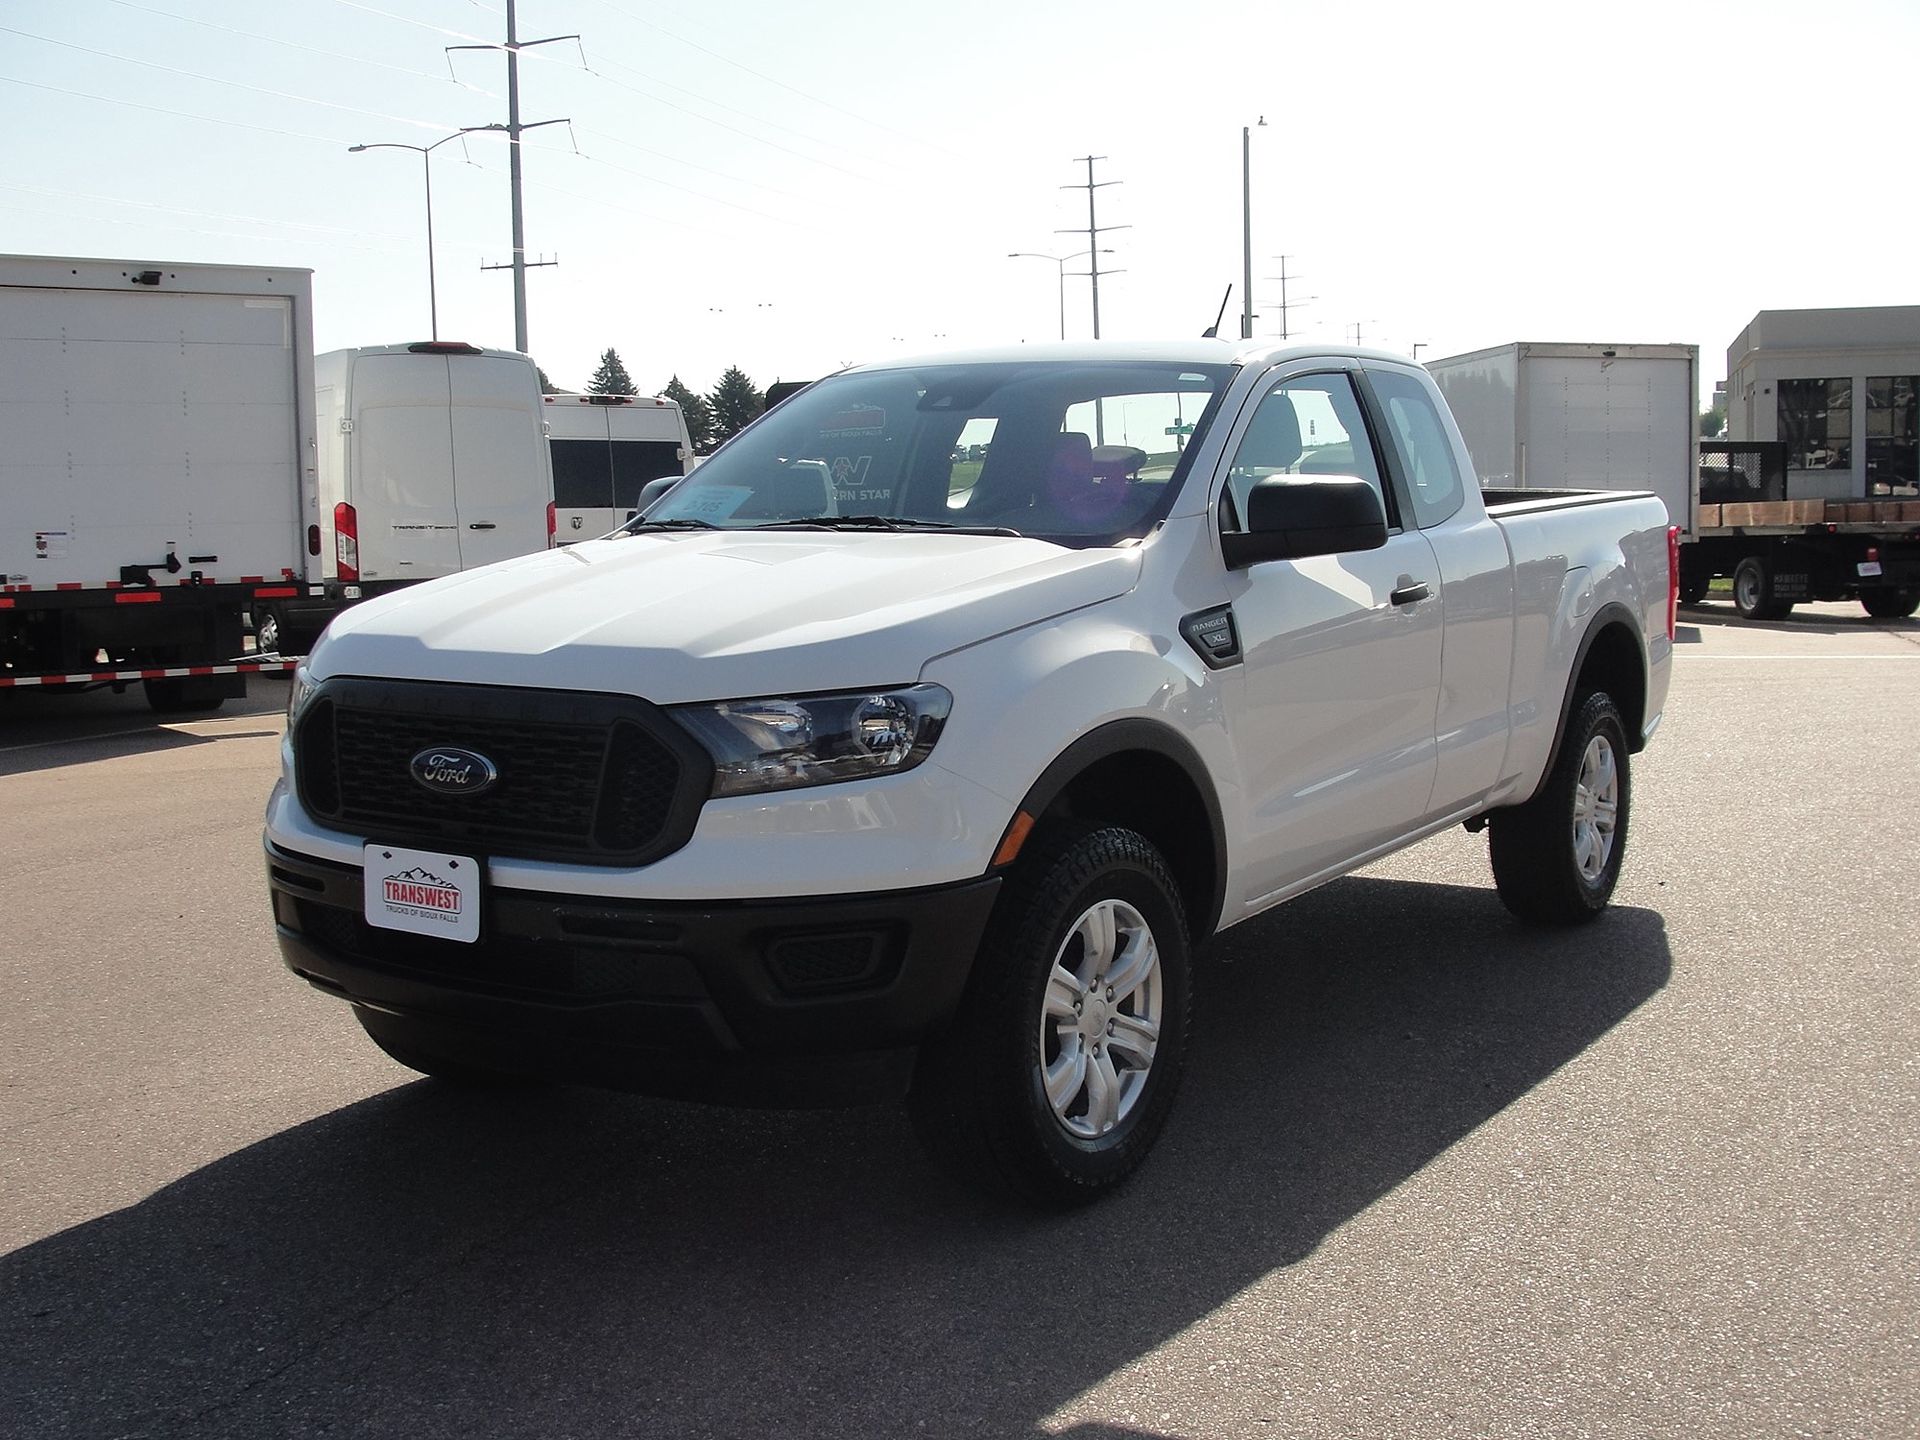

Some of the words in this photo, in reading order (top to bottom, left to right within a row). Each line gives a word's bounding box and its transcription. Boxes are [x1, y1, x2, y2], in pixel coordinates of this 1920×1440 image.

[860, 488, 891, 501] STAR
[1192, 616, 1227, 632] RANGER
[1212, 633, 1226, 643] XL
[424, 754, 472, 784] Ford
[384, 881, 460, 910] TRANSWEST
[386, 904, 409, 915] TRUCKS
[410, 908, 419, 917] OF
[420, 911, 439, 920] SIOUX
[440, 913, 459, 924] FALLS
